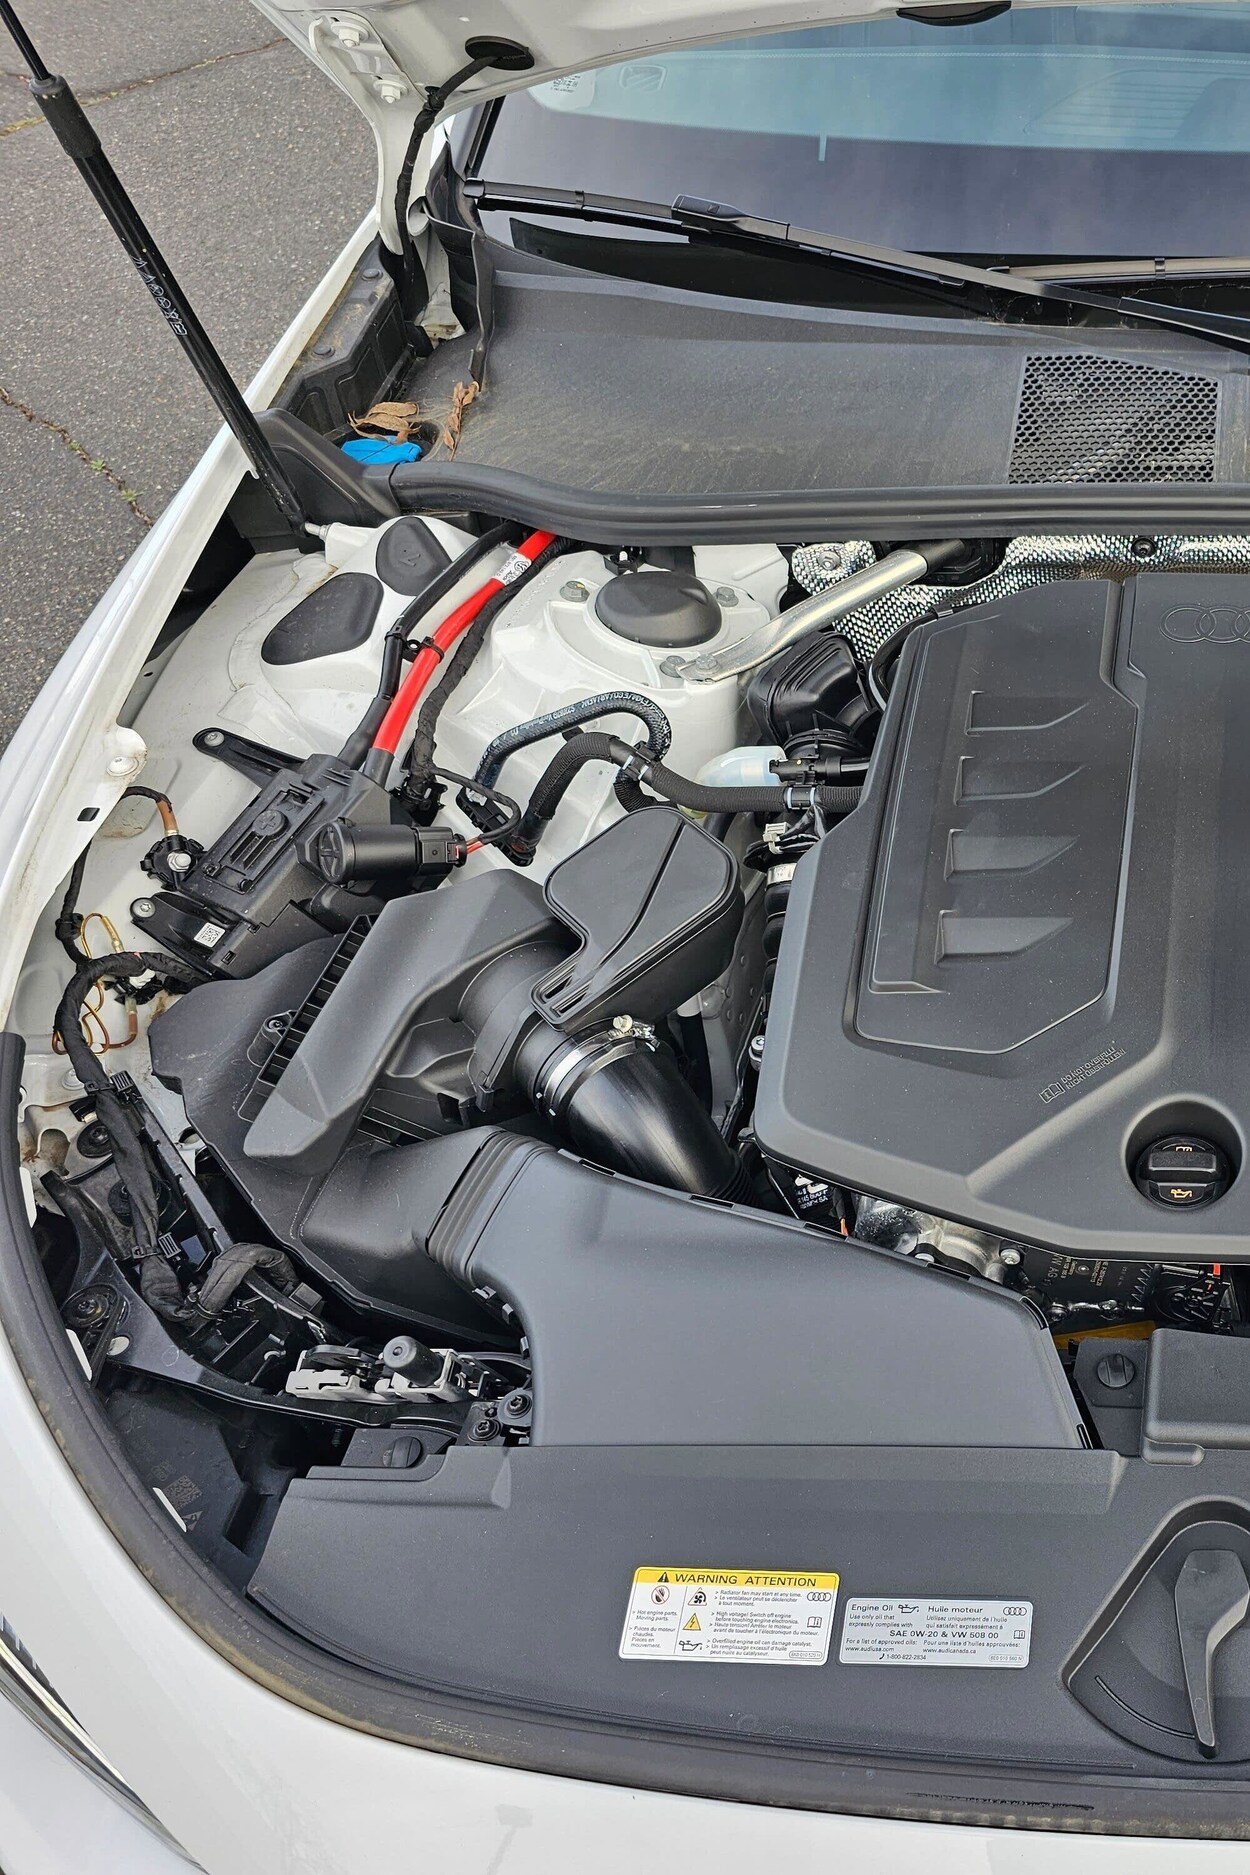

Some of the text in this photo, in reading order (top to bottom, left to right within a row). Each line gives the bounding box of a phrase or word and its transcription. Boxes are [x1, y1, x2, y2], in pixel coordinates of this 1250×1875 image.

[1060, 1074, 1072, 1084] DO
[1070, 1065, 1086, 1077] NOT
[1065, 1074, 1086, 1090] NICHT
[675, 1573, 817, 1587] WARNING ATTENTION
[851, 1604, 879, 1612] Engine
[927, 1605, 949, 1613] Huile
[910, 1630, 938, 1638] 0W-20
